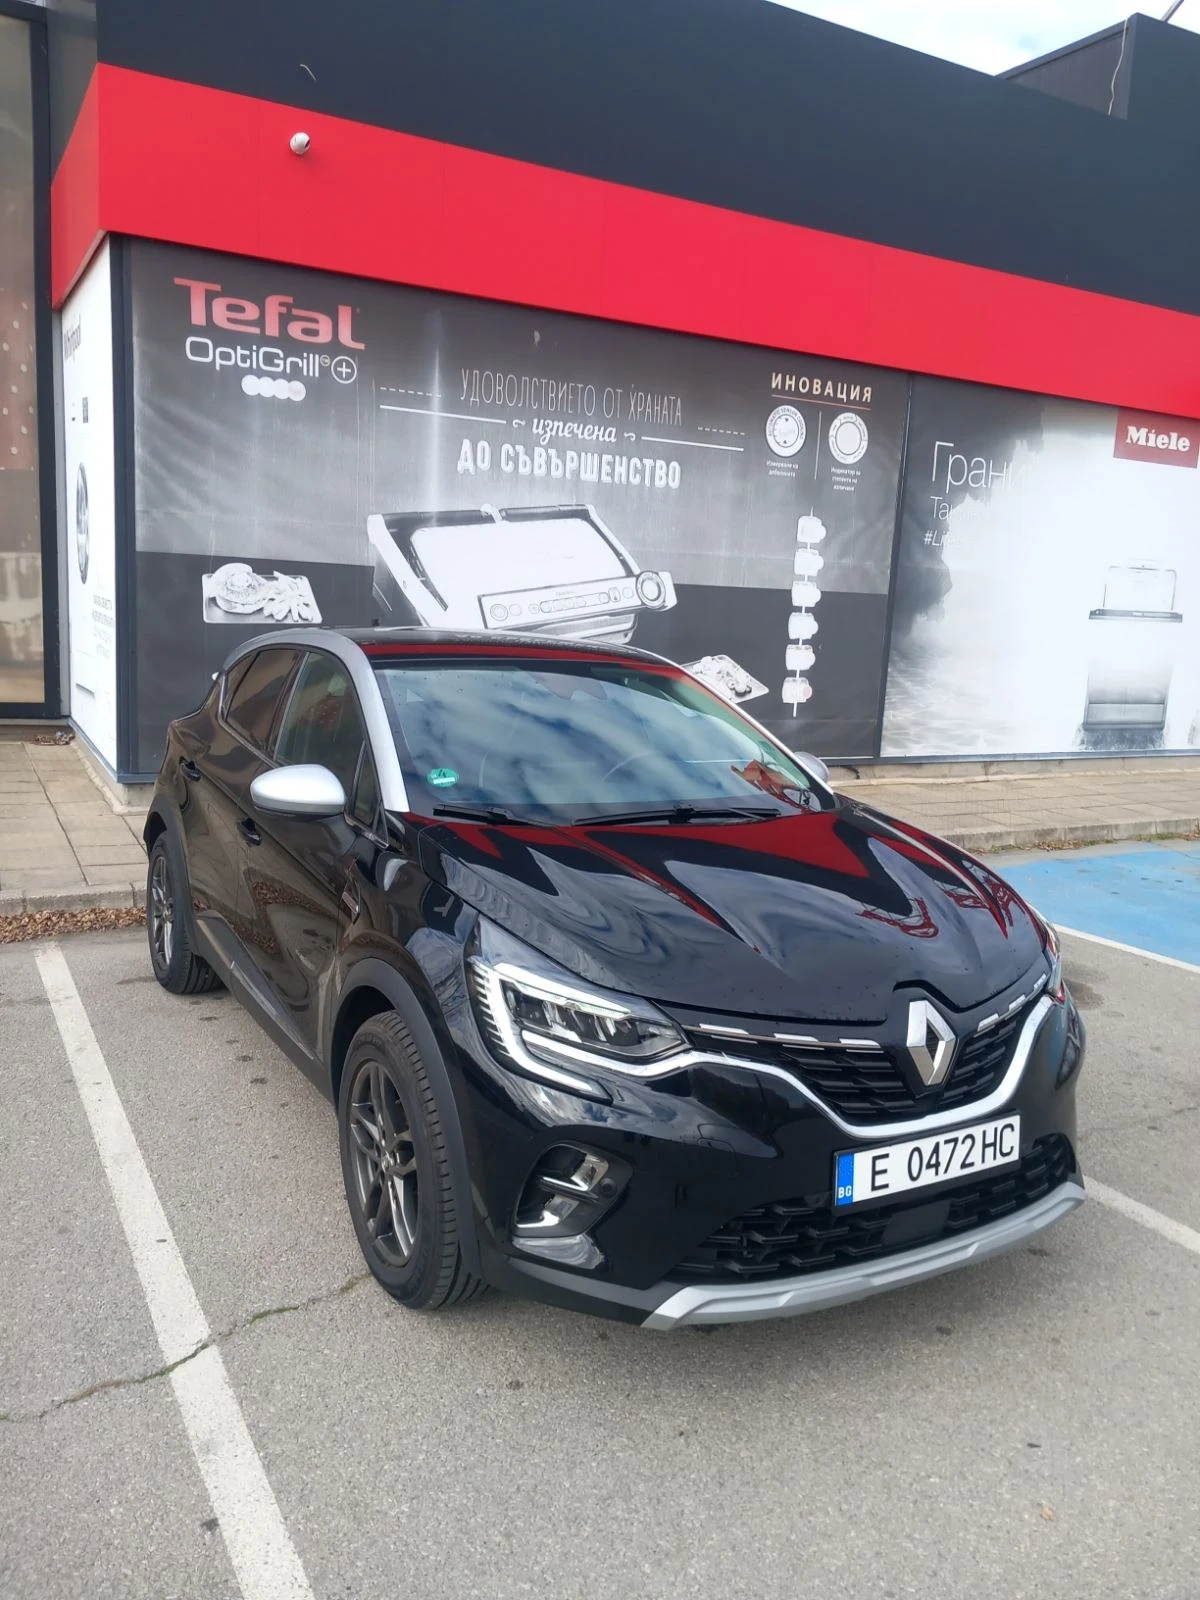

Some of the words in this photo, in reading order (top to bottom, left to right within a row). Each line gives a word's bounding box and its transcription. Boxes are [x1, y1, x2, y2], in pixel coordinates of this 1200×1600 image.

[174, 277, 365, 350] Tefal
[460, 367, 596, 417] УДОВОЛСТВИЕТО
[603, 387, 623, 419] ОТ
[628, 386, 682, 426] ХРАНАТА
[771, 372, 872, 403] ИНОВАЦИЯ
[532, 418, 617, 446] изпечена
[1125, 425, 1190, 452] Miele
[457, 439, 491, 475] ДО
[500, 443, 681, 489] СЪВЪРШЕНСТВО
[871, 1153, 890, 1192] E
[838, 1185, 852, 1199] BG
